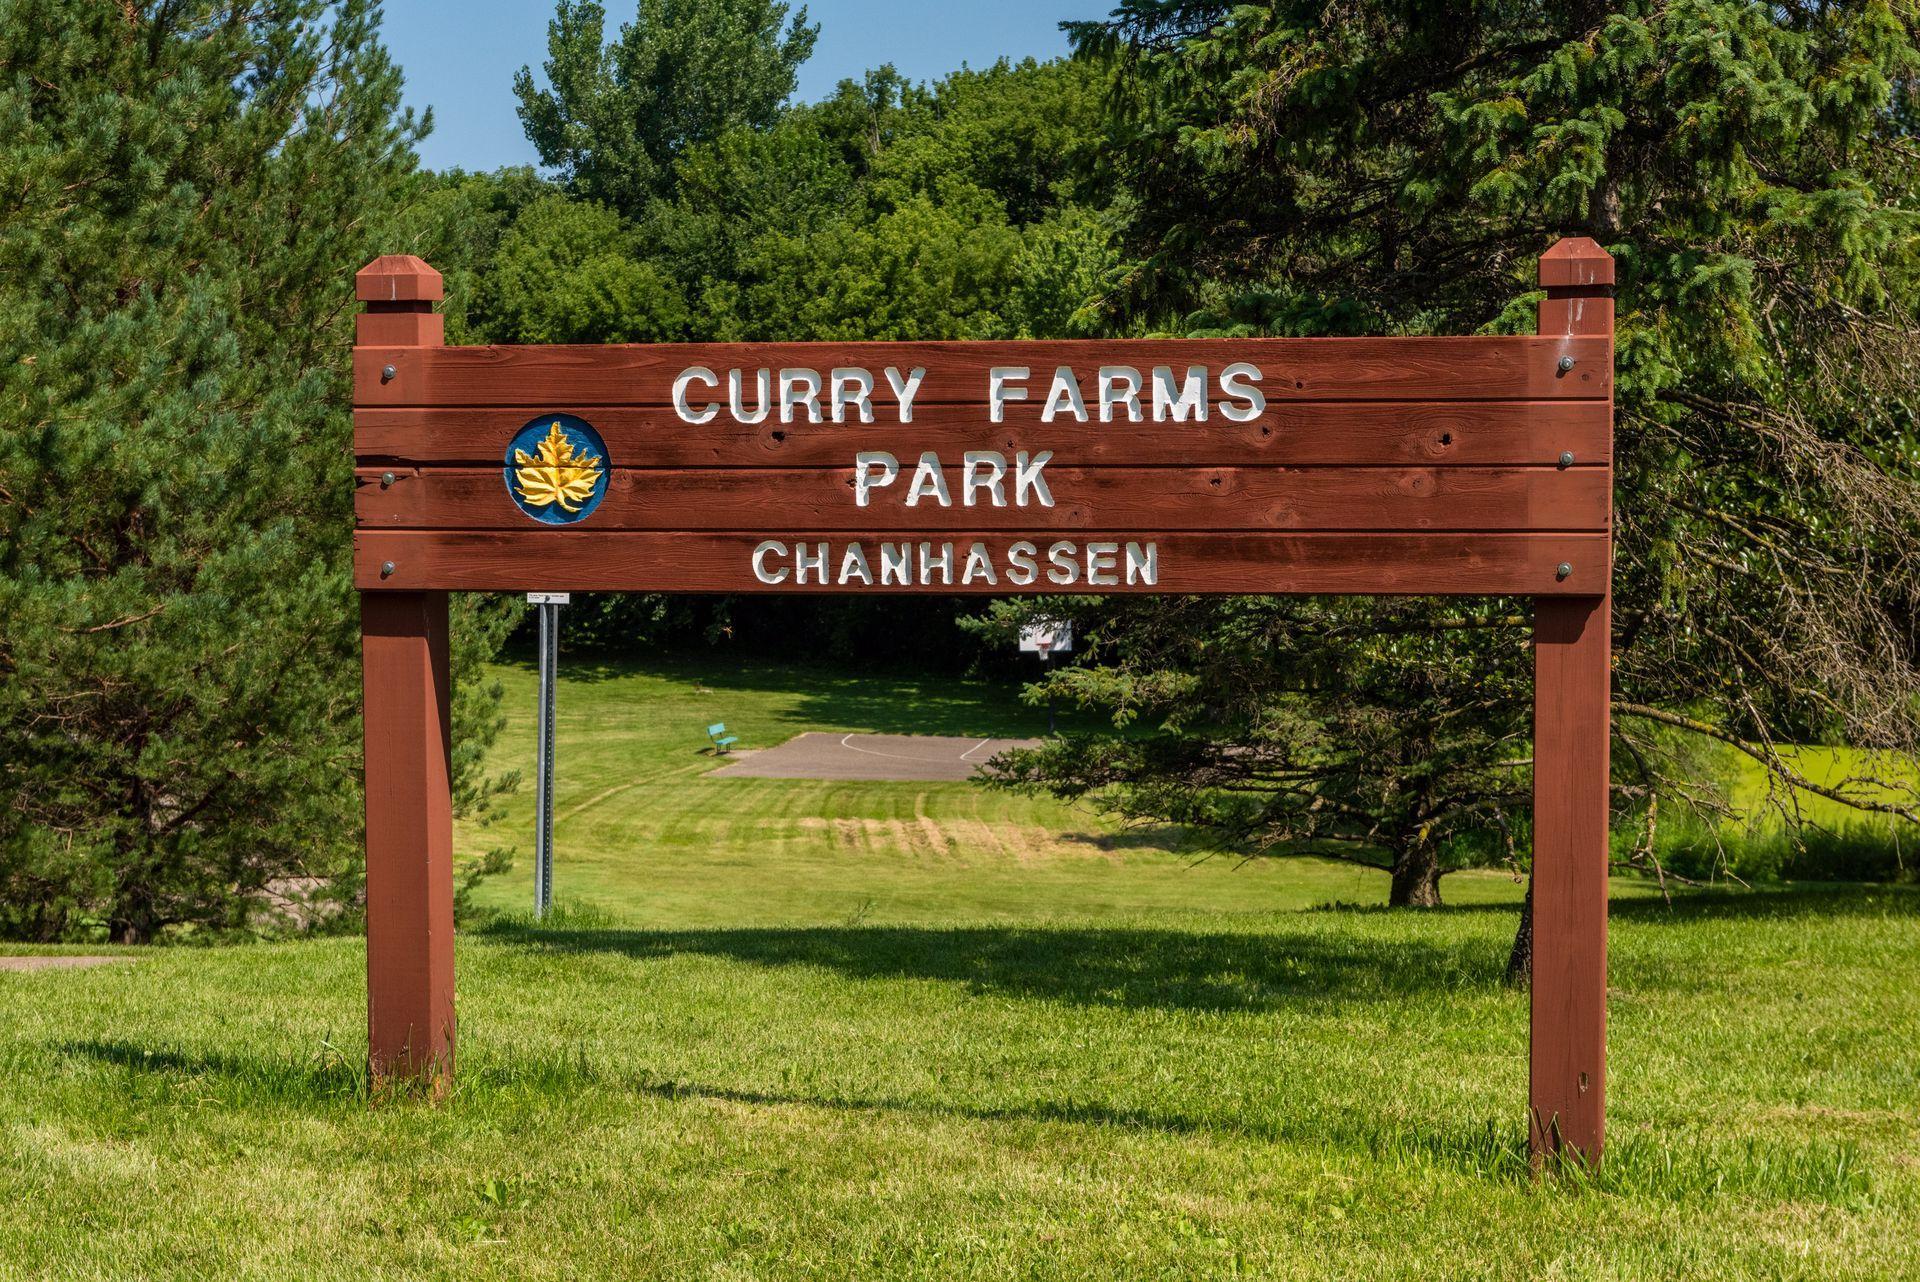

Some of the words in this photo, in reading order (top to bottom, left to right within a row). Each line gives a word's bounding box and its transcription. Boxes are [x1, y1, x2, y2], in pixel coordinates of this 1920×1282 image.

[672, 366, 926, 425] CURRY
[989, 362, 1267, 423] FARMS
[855, 450, 1055, 508] PARK
[752, 540, 1158, 586] CHANHASSEN
